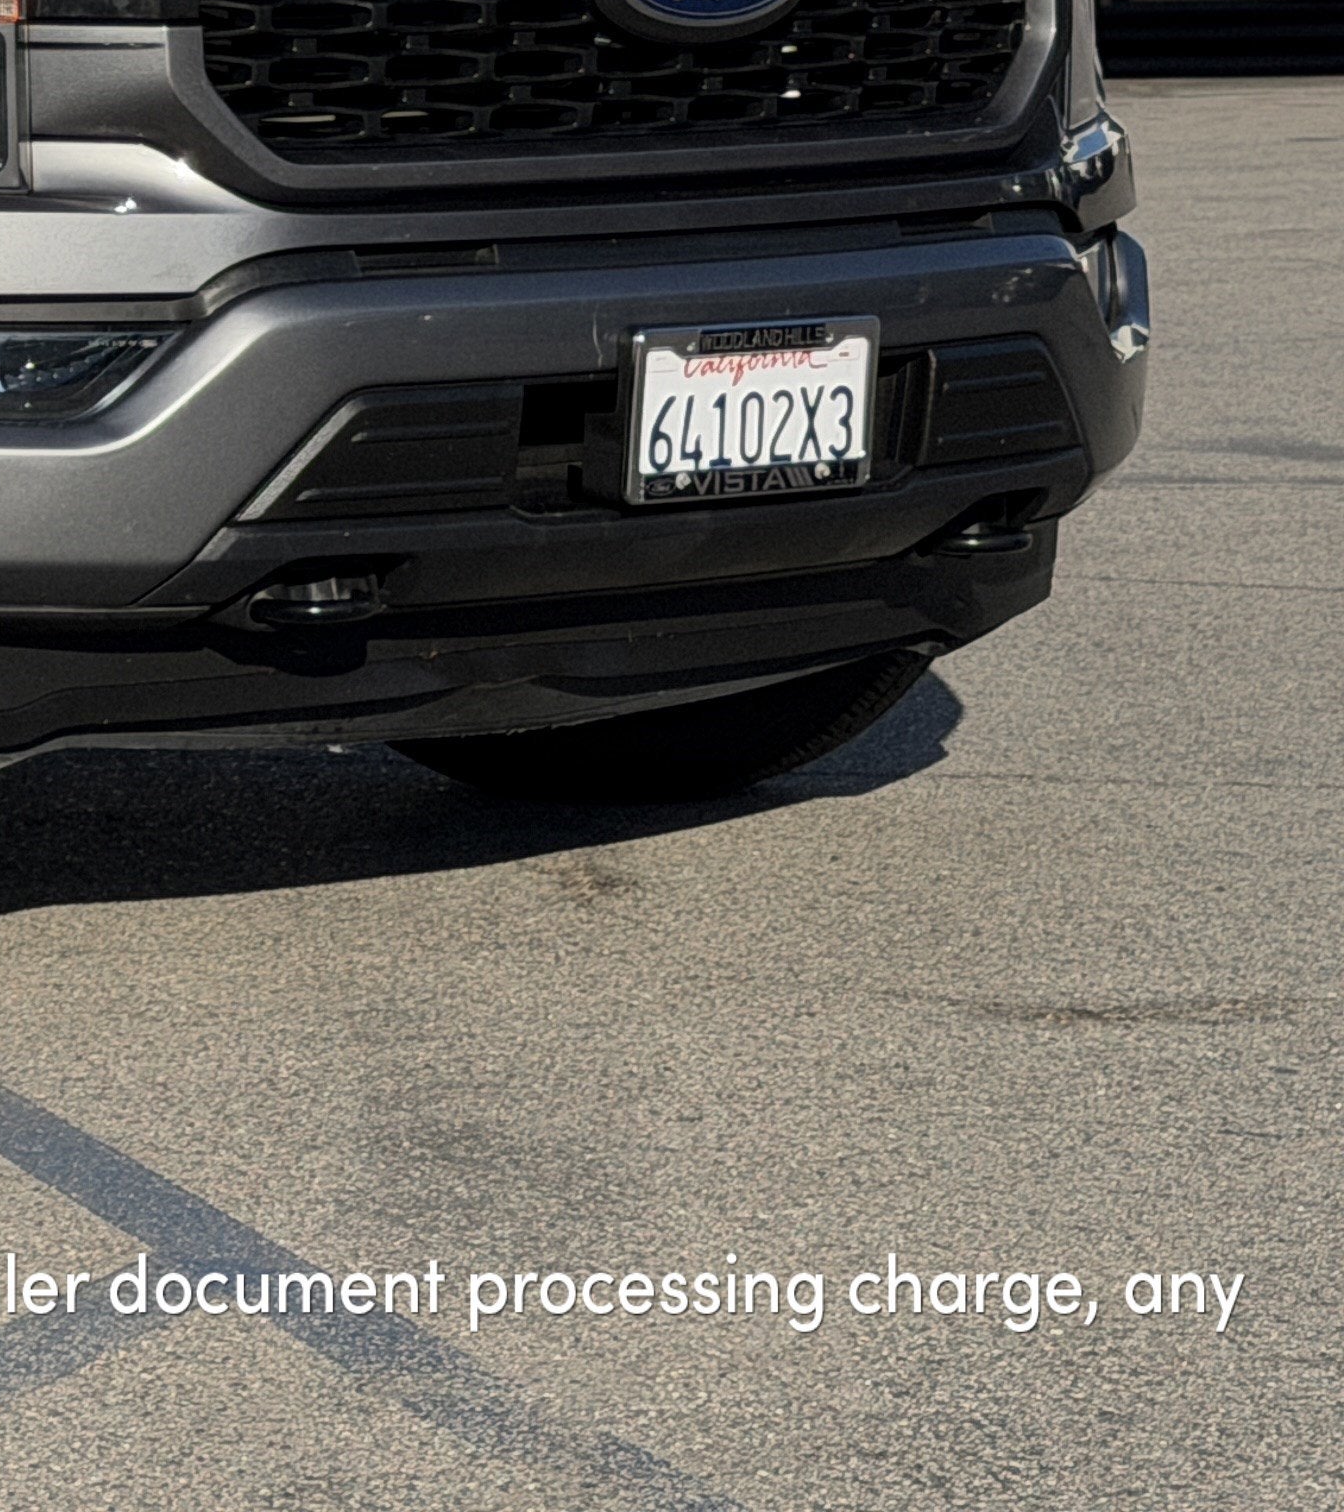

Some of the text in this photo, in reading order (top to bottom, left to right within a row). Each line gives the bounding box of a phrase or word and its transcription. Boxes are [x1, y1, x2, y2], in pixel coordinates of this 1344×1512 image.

[701, 326, 825, 352] WOODLAND HILLS
[683, 350, 828, 387] California
[648, 384, 854, 472] 64102X3
[693, 468, 789, 496] VISTA
